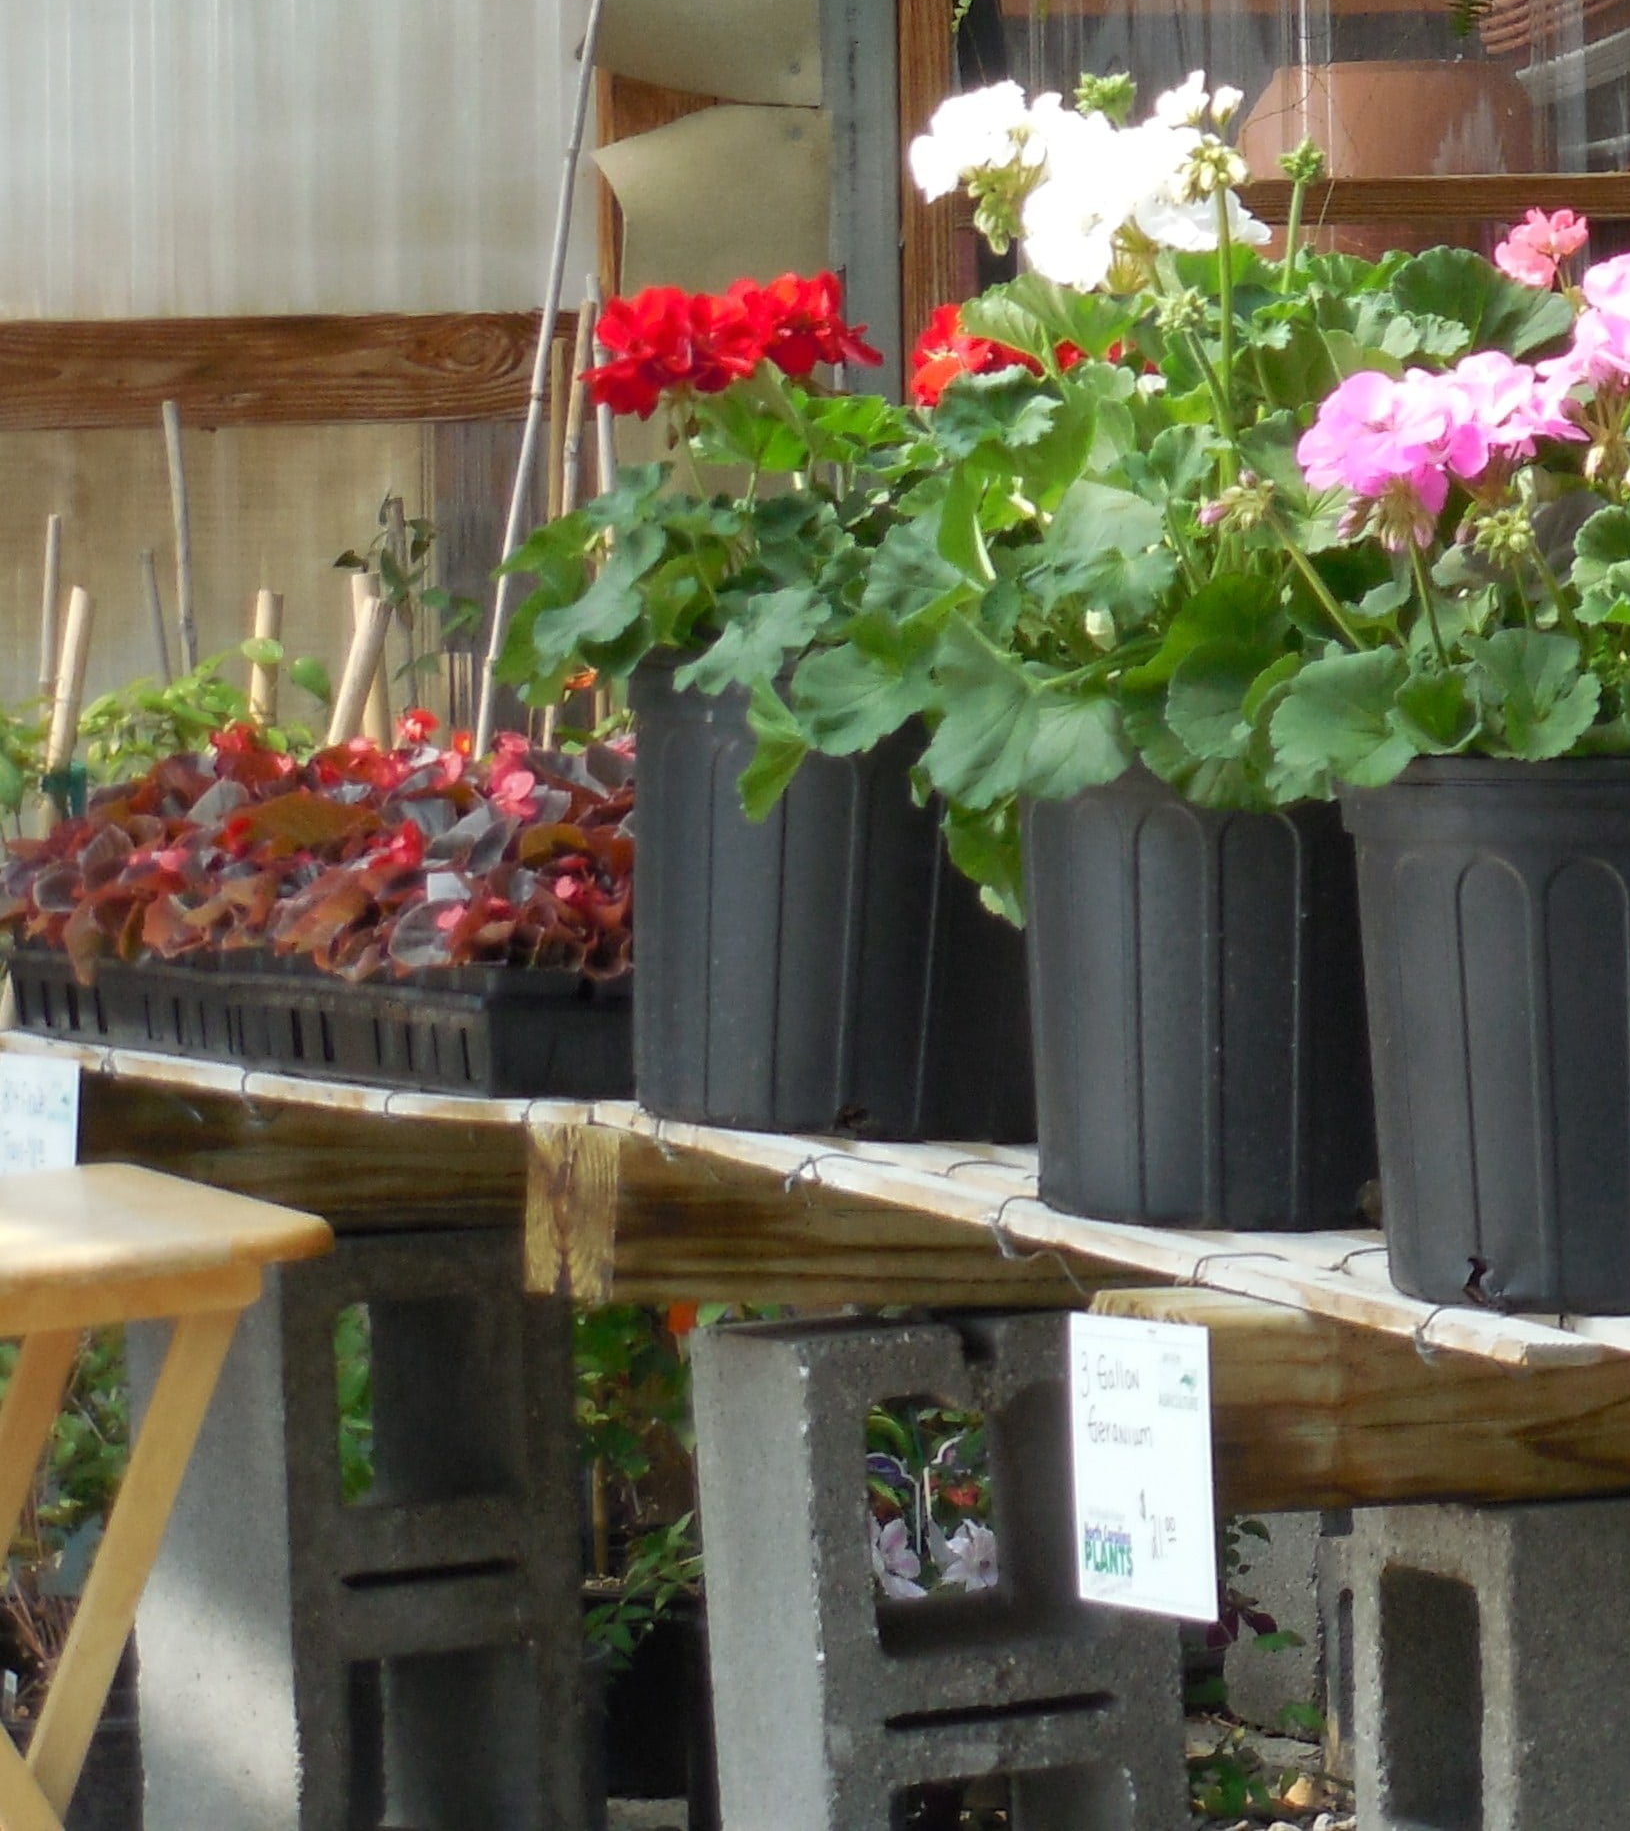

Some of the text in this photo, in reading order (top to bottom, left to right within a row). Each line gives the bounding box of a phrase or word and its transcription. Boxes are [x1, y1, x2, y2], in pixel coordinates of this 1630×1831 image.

[1082, 1350, 1140, 1397] 3 Gallon
[1088, 1404, 1152, 1447] Geranium
[1085, 1540, 1133, 1577] PLANTS
